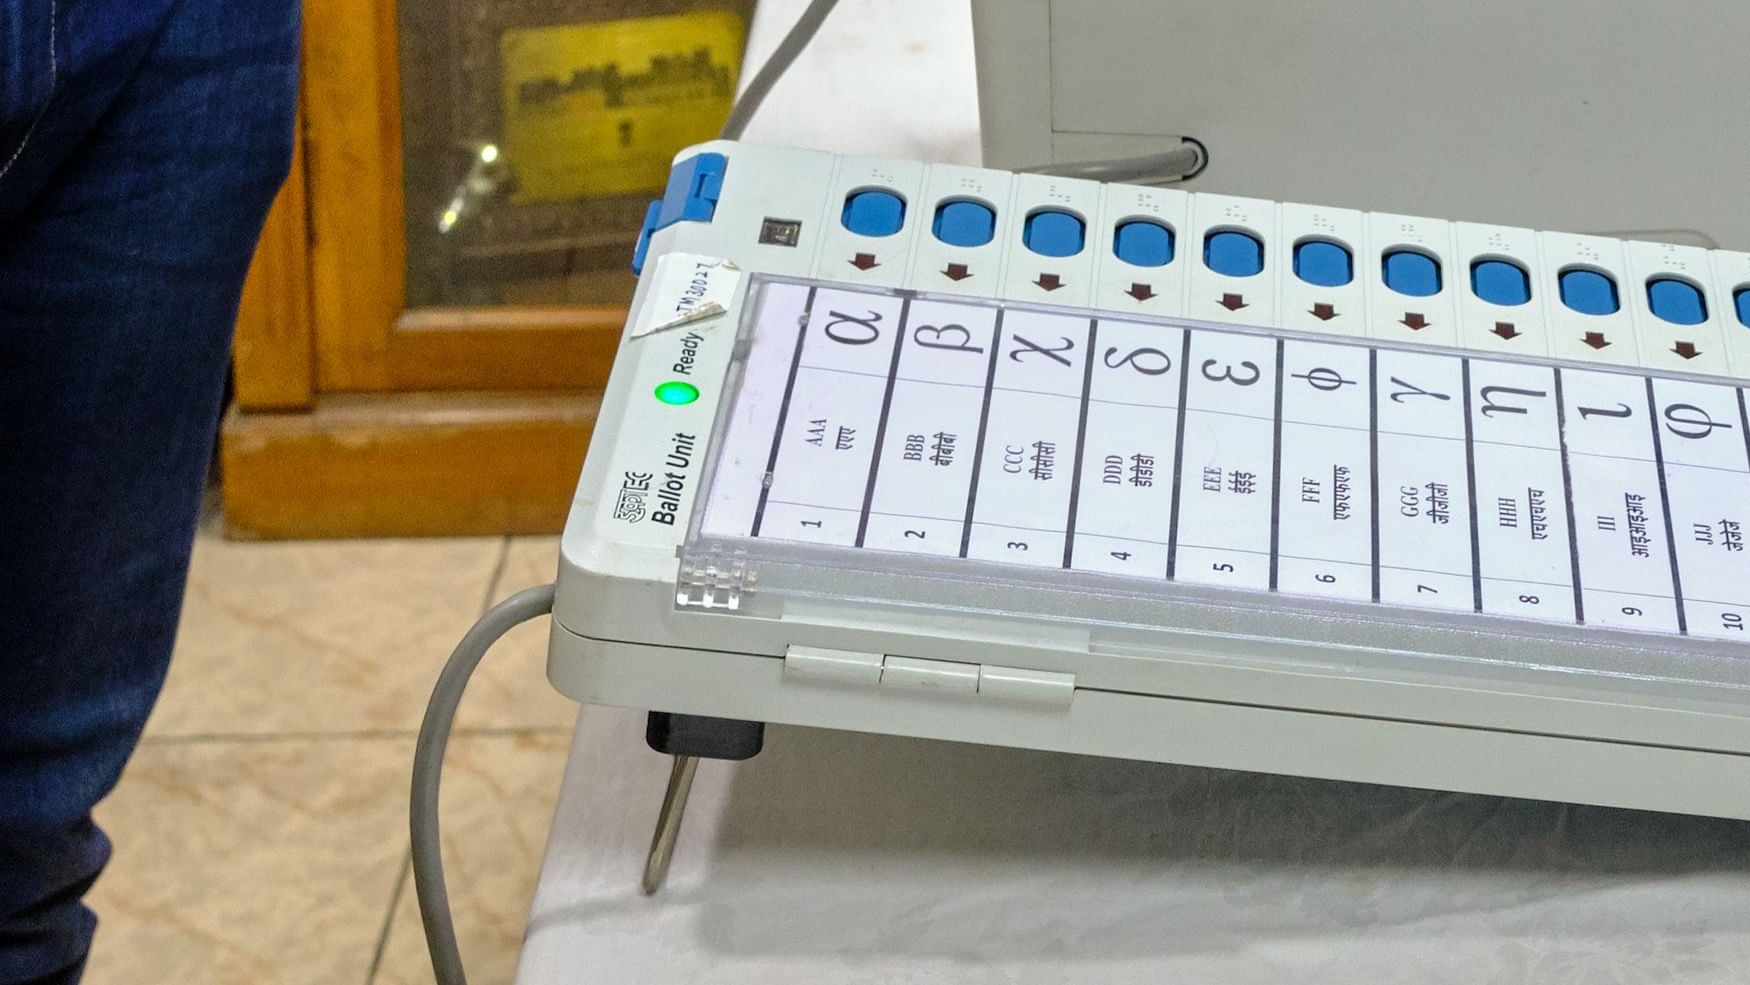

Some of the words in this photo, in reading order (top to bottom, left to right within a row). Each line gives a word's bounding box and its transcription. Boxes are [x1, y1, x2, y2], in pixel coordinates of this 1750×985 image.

[673, 331, 704, 375] Ready
[805, 419, 827, 447] AAA
[666, 432, 696, 469] Unit
[903, 435, 925, 461] BBB
[1003, 445, 1024, 473] CCC
[1103, 455, 1123, 484] DDD
[1203, 467, 1221, 492] EEE
[652, 472, 686, 526] Ballot
[1302, 477, 1320, 503] FFF
[1401, 486, 1419, 517] GGG
[1498, 498, 1517, 528] HHH
[1597, 516, 1616, 531] III
[904, 530, 925, 539] 2
[1693, 524, 1713, 545] JJJ
[1007, 542, 1028, 552] 3
[1111, 552, 1131, 560] 4
[1213, 563, 1234, 572] 5
[1315, 574, 1336, 583] 6
[1417, 584, 1438, 593] 7
[1519, 594, 1540, 604] 8
[1622, 607, 1642, 616] 9
[1721, 613, 1743, 631] 10
